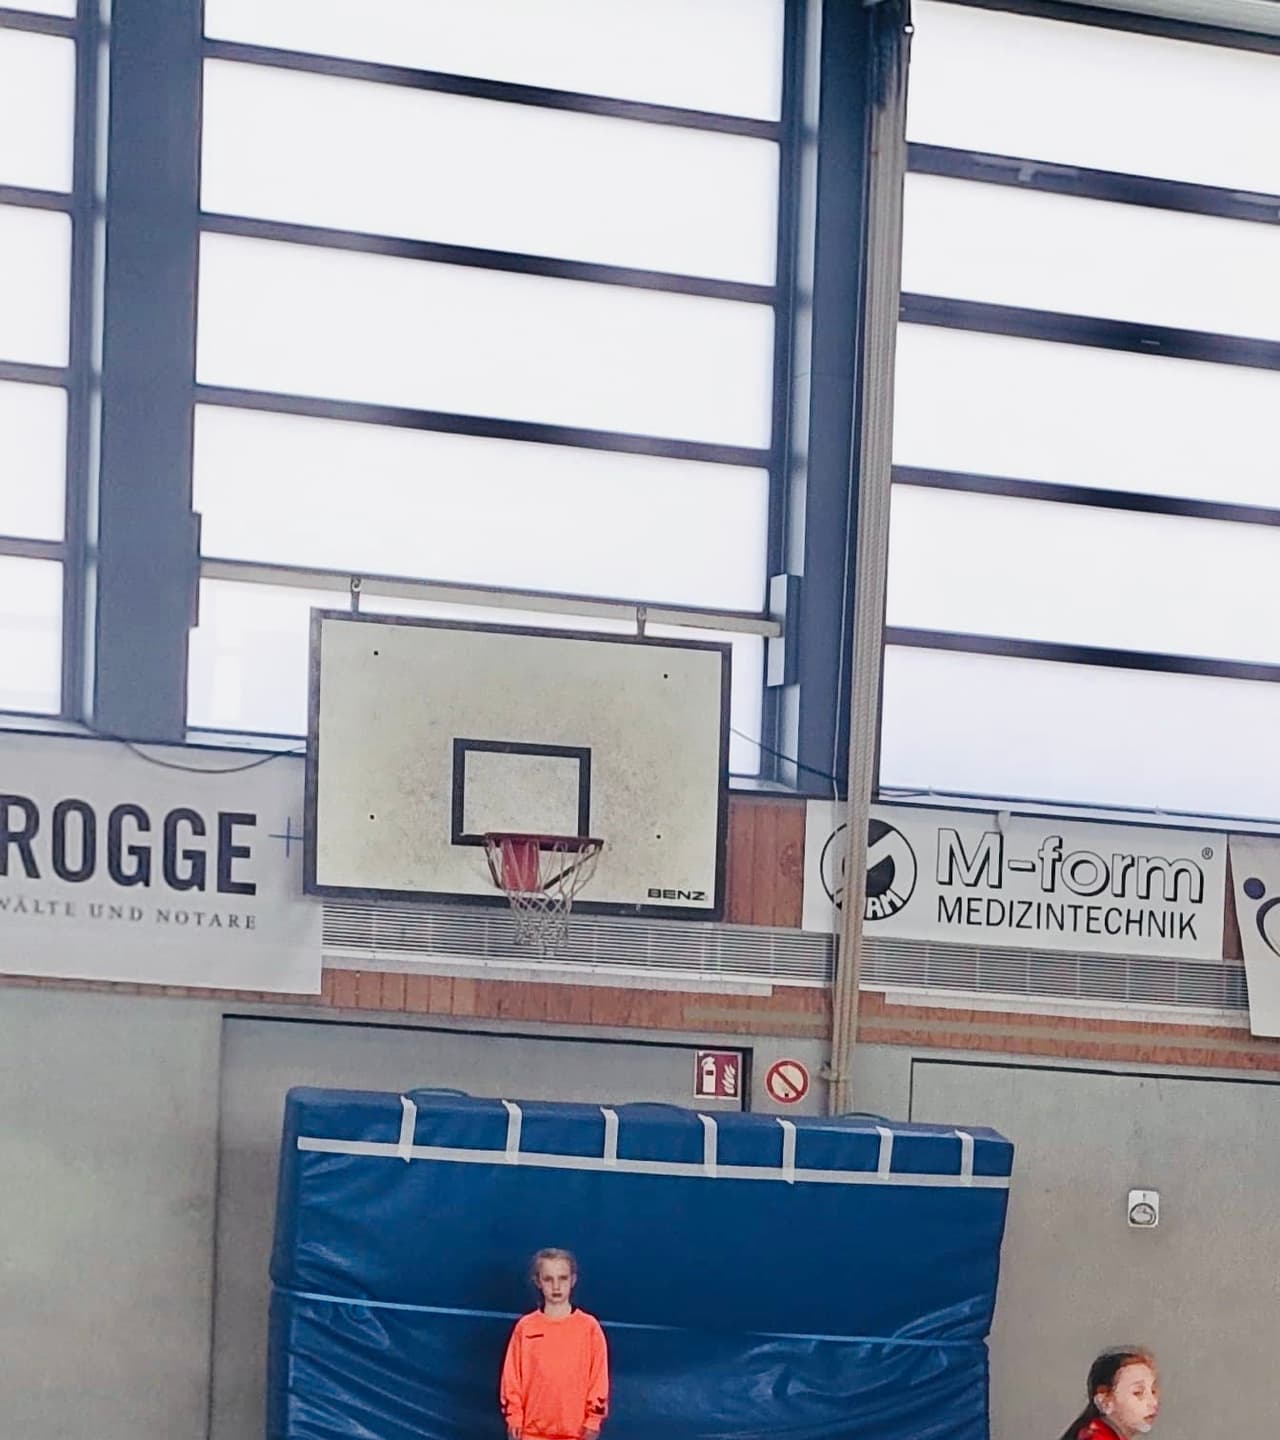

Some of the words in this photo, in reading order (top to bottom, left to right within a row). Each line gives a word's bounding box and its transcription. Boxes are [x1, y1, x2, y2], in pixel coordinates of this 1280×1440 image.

[0, 793, 257, 896] ROGGE
[935, 826, 1206, 904] M-form
[90, 903, 145, 922] UND
[155, 908, 257, 931] NOTARE
[647, 887, 706, 901] BENZ
[937, 894, 1198, 941] MEDIZINTECHNIK
